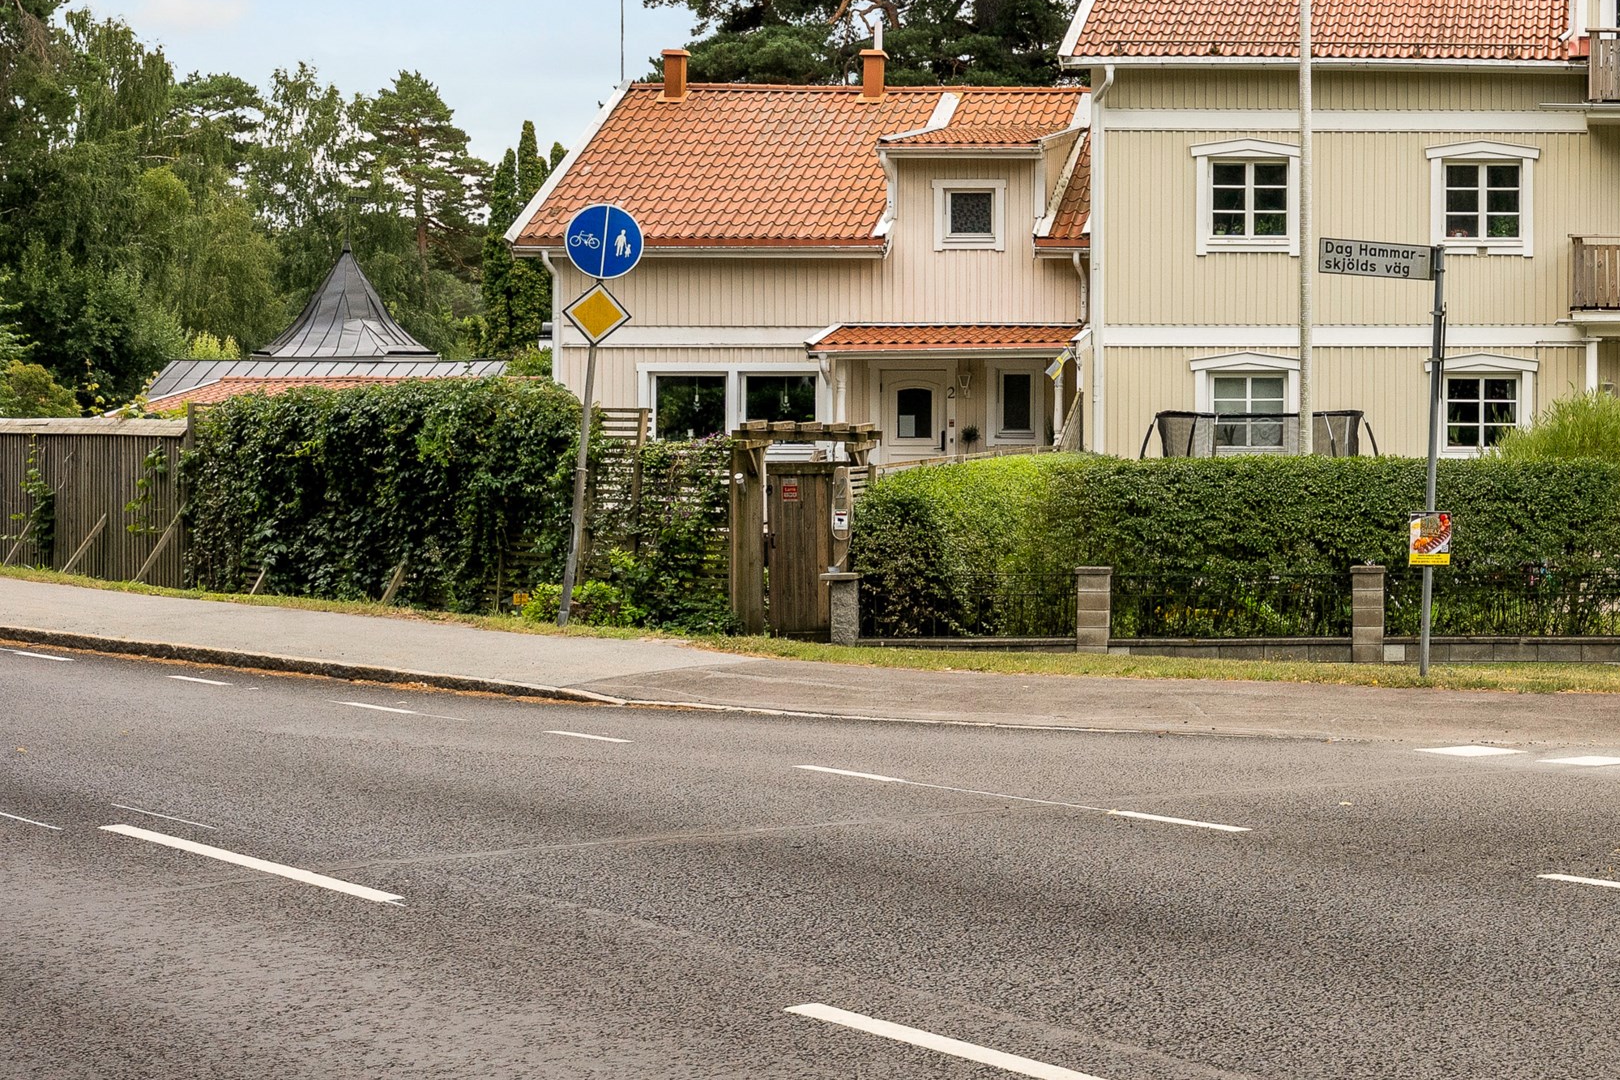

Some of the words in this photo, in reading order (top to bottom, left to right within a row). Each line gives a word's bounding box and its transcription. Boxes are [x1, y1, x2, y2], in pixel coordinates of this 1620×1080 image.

[1325, 241, 1353, 257] Dag
[1359, 243, 1426, 260] Hammar-
[1324, 257, 1377, 272] skjölds
[1385, 262, 1411, 277] väg
[947, 386, 956, 399] 2
